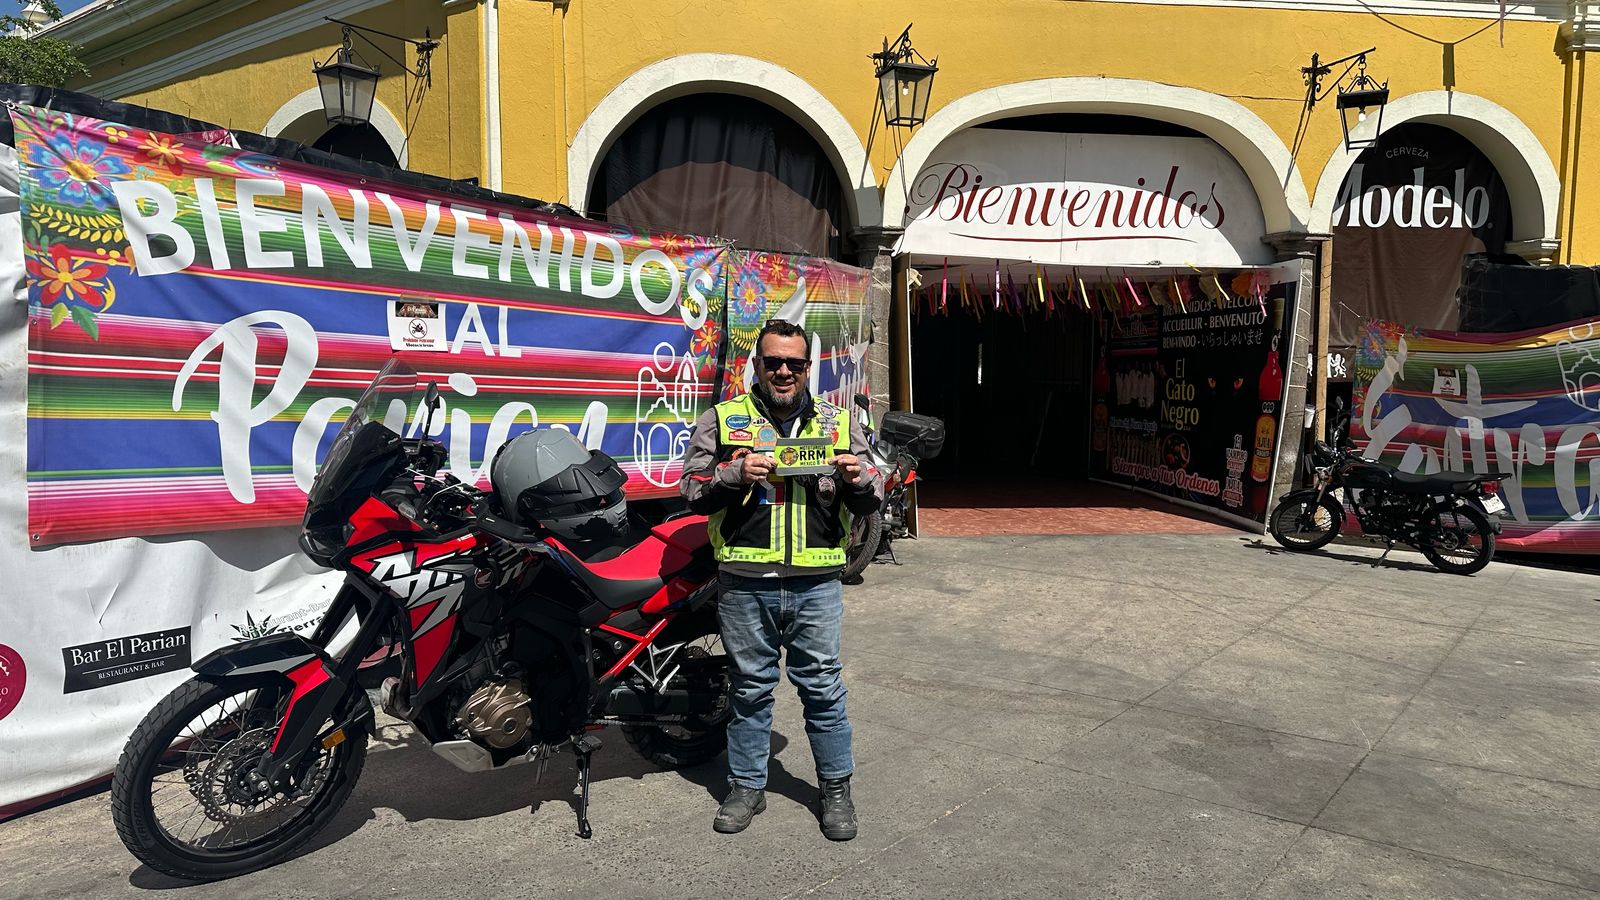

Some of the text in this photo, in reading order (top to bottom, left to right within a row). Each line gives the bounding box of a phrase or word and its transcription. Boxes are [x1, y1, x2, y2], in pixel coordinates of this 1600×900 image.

[1385, 144, 1431, 161] CERVEZA
[904, 164, 1226, 230] Bienvenidos
[1333, 163, 1490, 229] Modelo
[111, 177, 713, 331] BIENVENIDOS
[450, 304, 523, 359] AL
[1162, 312, 1265, 333] ACCUEILLIR BENVENUTO
[1176, 358, 1185, 378] El
[1166, 379, 1196, 402] Gato
[1161, 400, 1200, 431] Negro
[799, 449, 826, 461] RRM
[1112, 457, 1155, 484] Siempre
[1175, 470, 1220, 494] Ordenes
[70, 632, 187, 668] Bar El Parian
[97, 664, 144, 680] RESTAURANT
[151, 660, 165, 669] BAR
